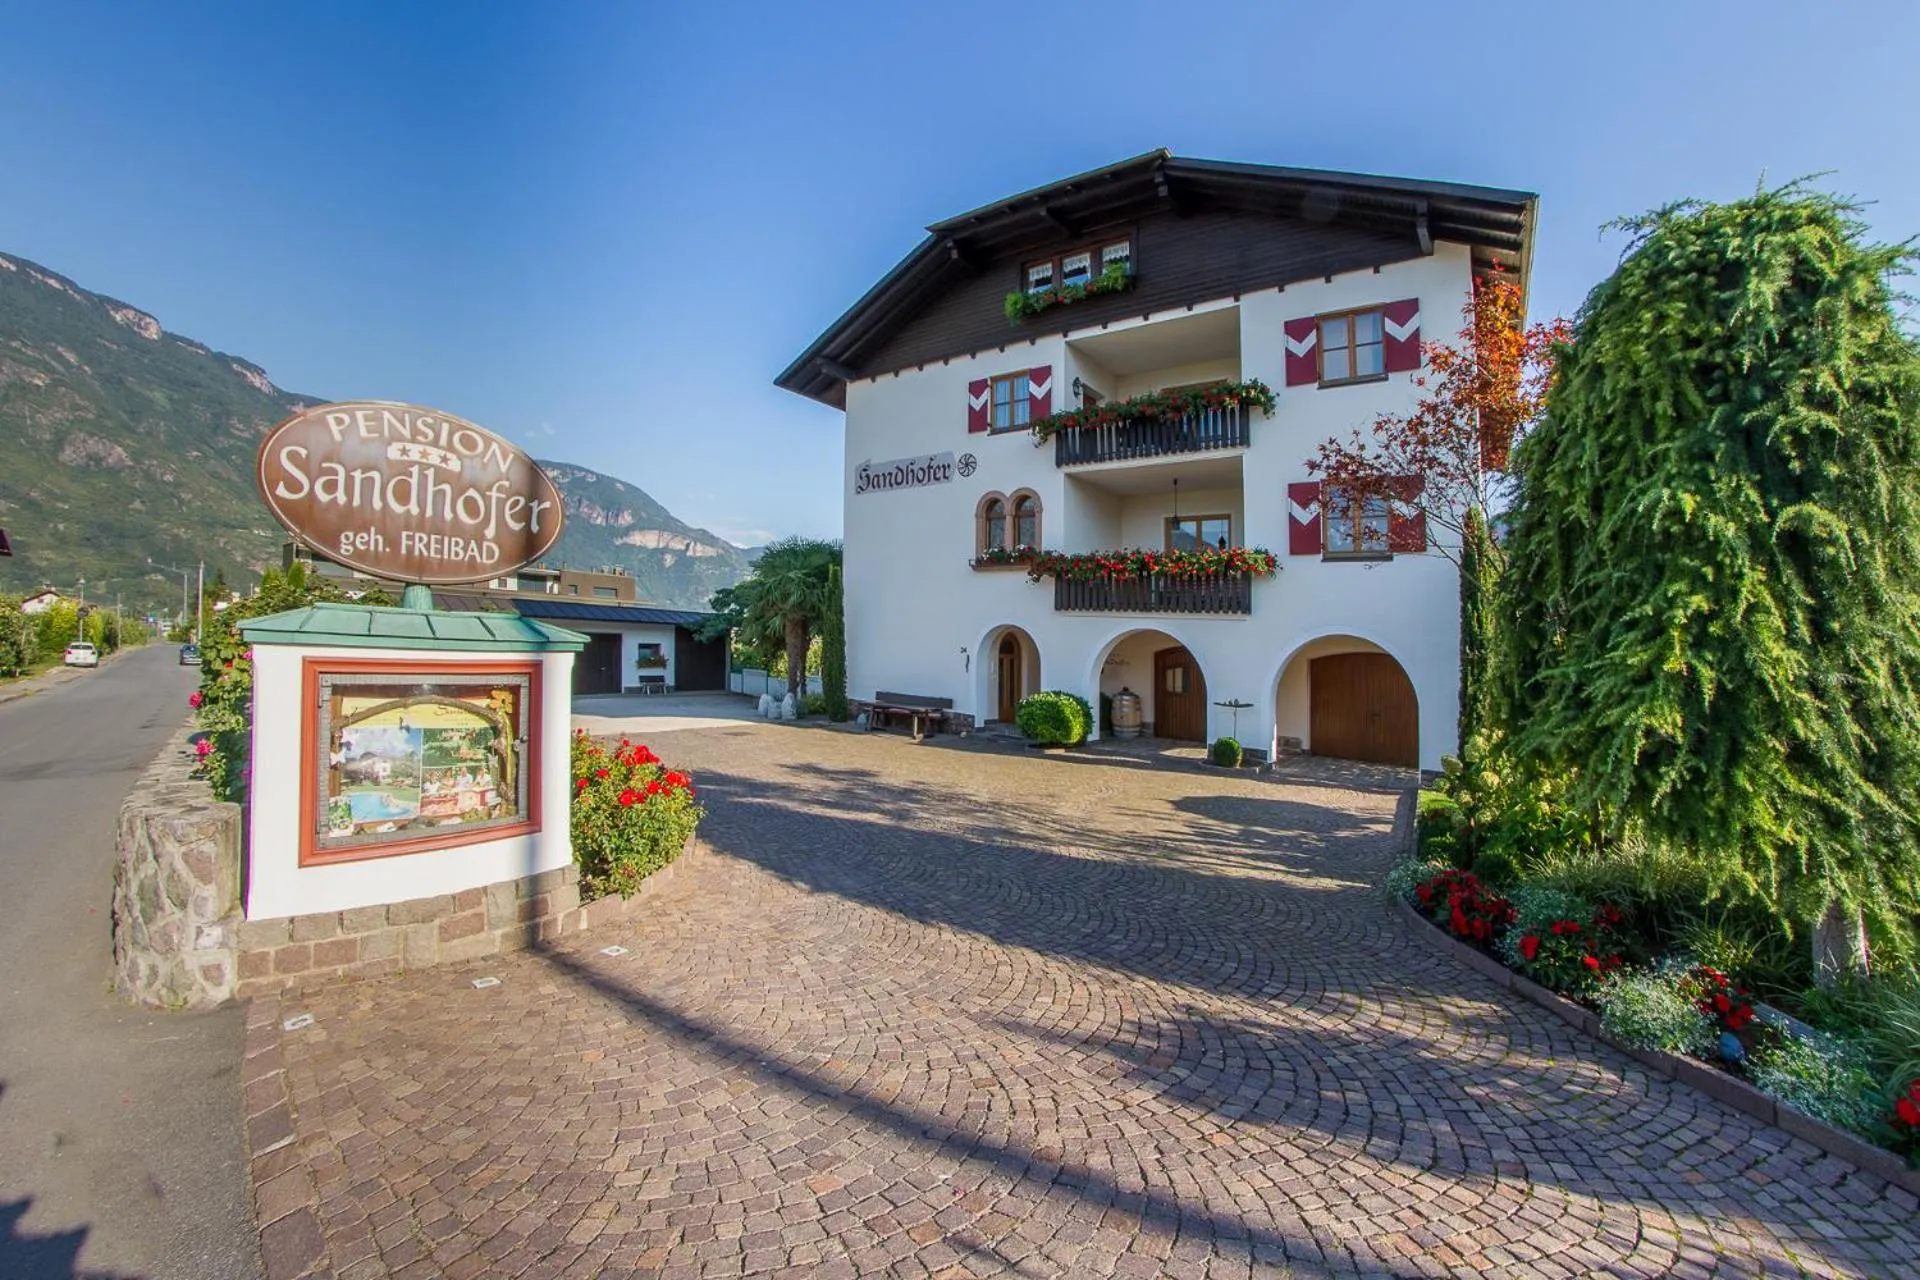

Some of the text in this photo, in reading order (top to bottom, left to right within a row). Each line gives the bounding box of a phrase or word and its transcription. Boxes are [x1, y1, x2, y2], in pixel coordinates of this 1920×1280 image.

[327, 410, 514, 473] PENSION
[275, 445, 551, 539] Sandhofer
[856, 455, 951, 494] Sandhofer
[340, 526, 500, 564] geh. FREIBAD
